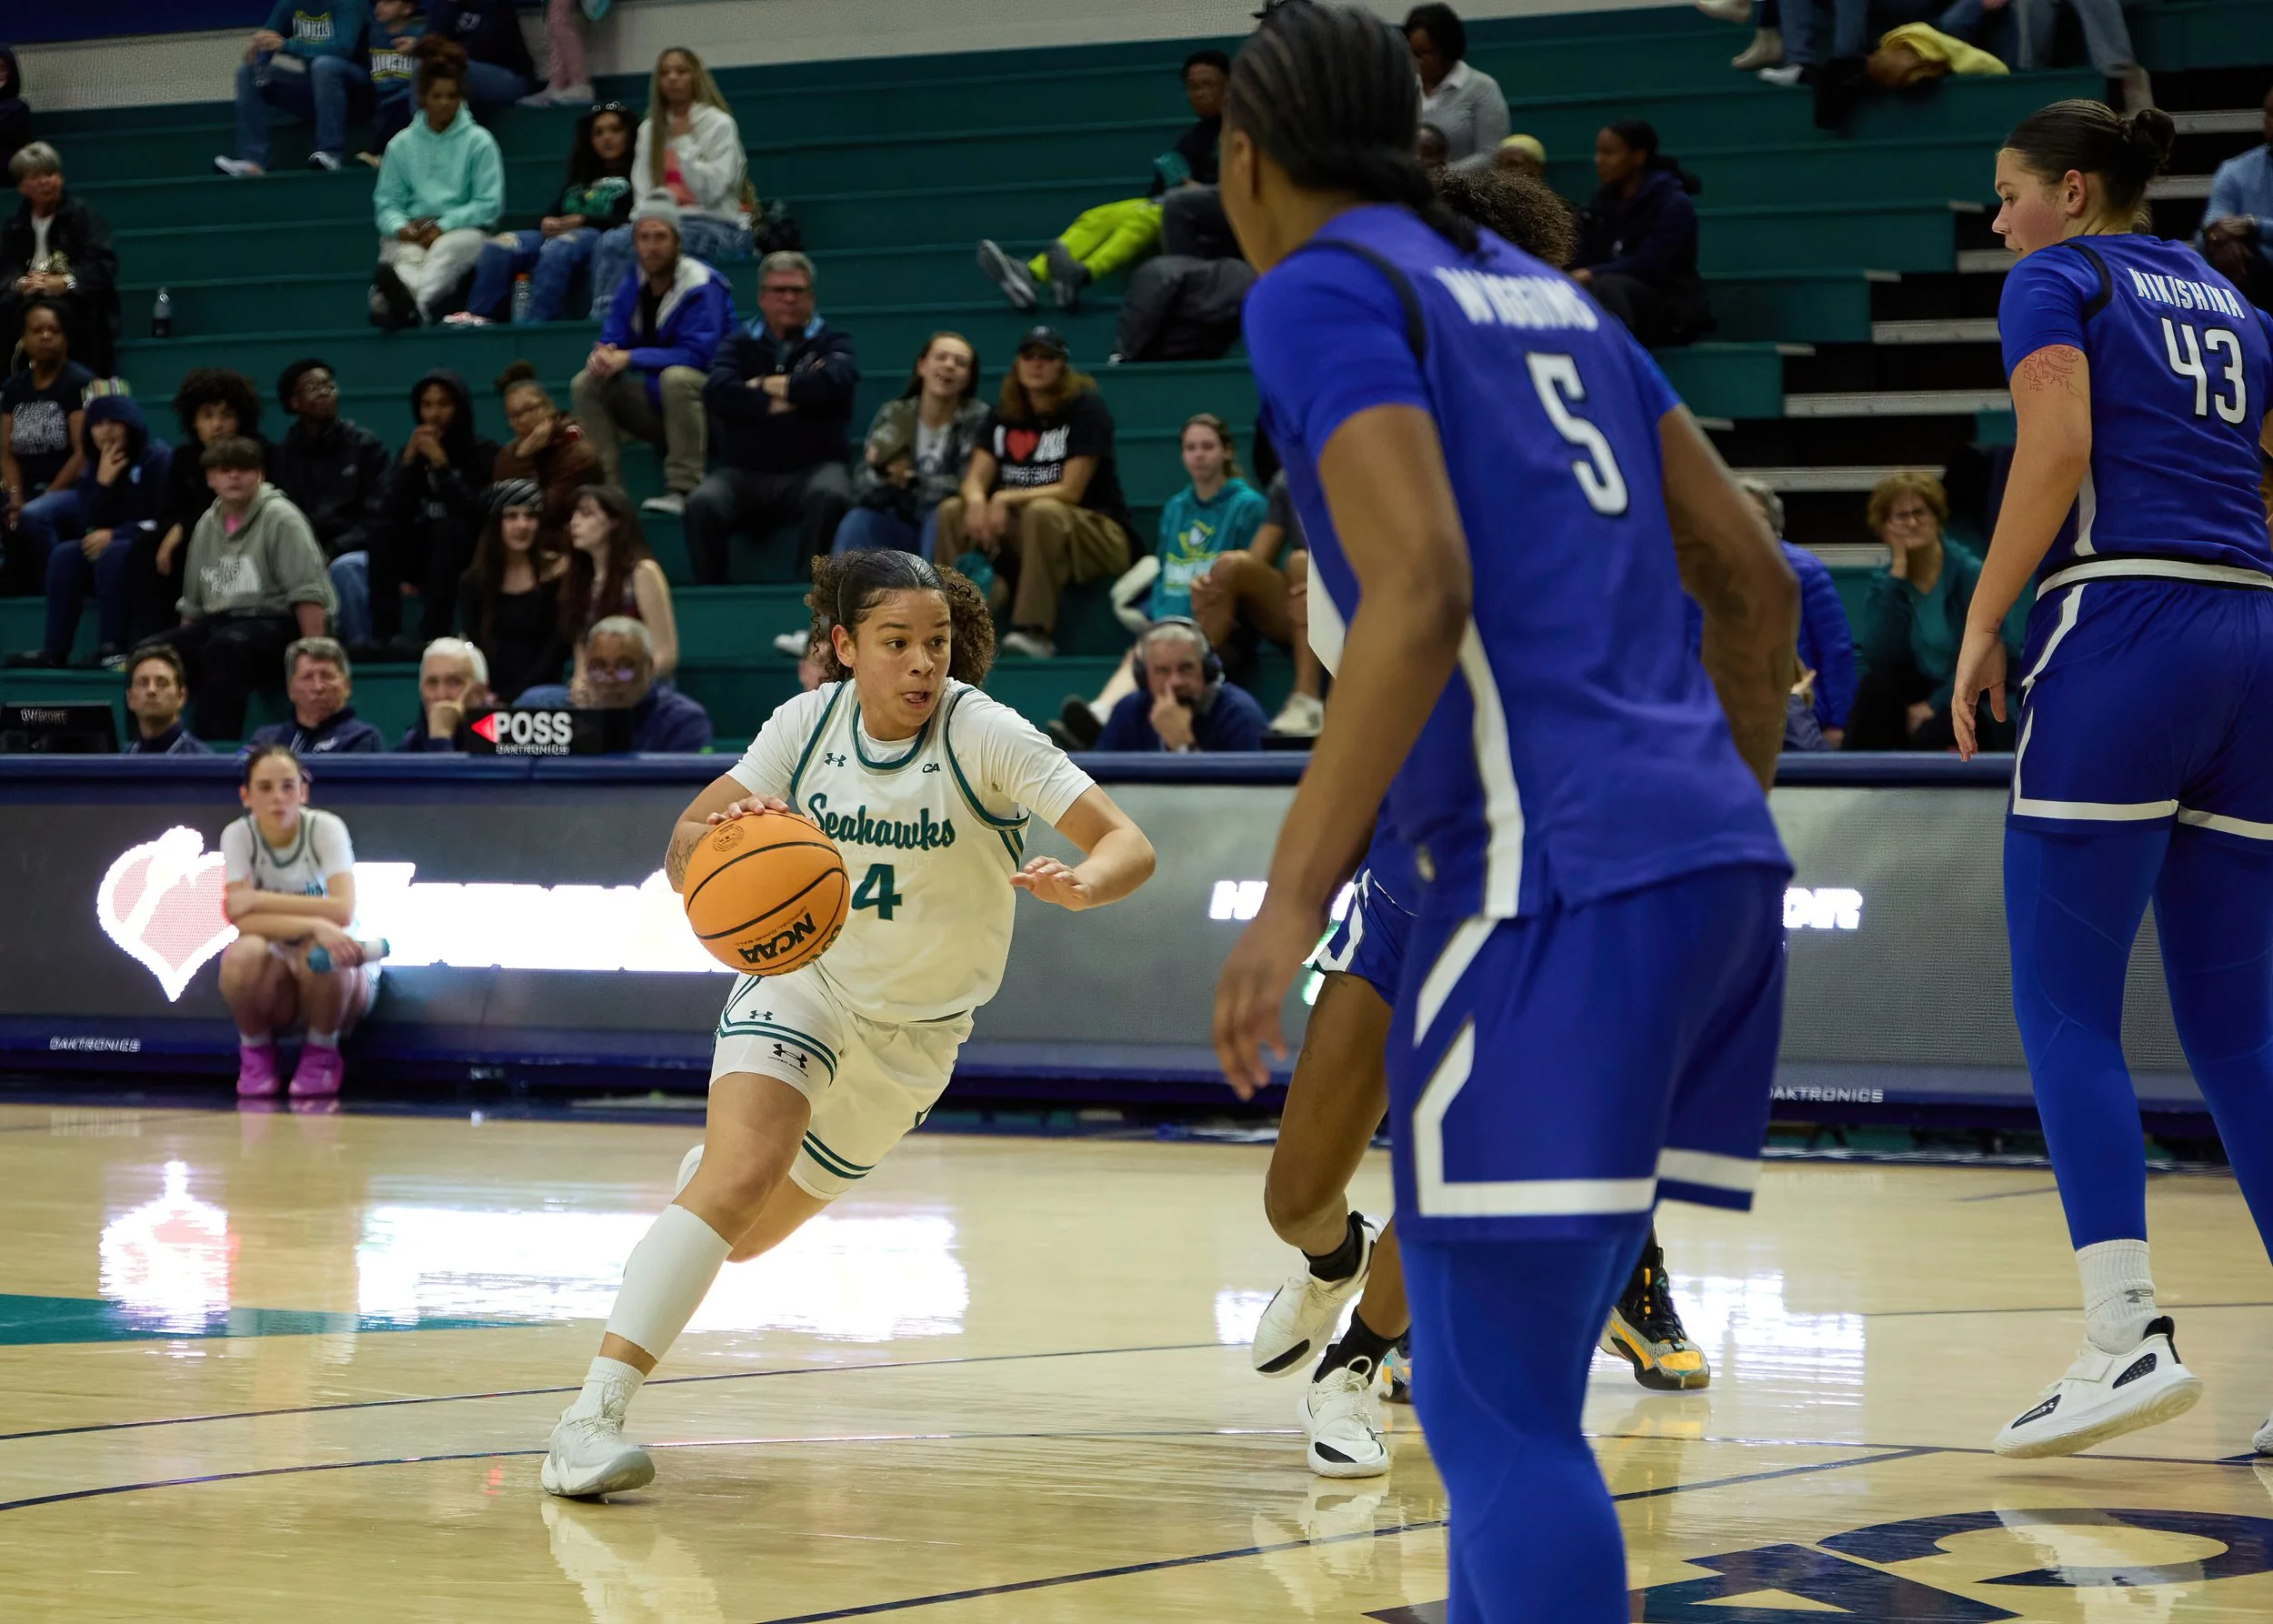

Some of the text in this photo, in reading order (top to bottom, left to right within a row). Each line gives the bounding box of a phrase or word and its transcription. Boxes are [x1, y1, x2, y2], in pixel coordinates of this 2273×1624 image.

[2127, 267, 2245, 319] NIKISHINA
[2161, 317, 2247, 424] 43
[1525, 351, 1628, 516] 5
[496, 711, 573, 745] POSS
[808, 792, 956, 851] Seahawks
[851, 863, 903, 920] 4
[738, 911, 817, 965] NCAA
[1770, 1086, 1884, 1103] AKTRONICS
